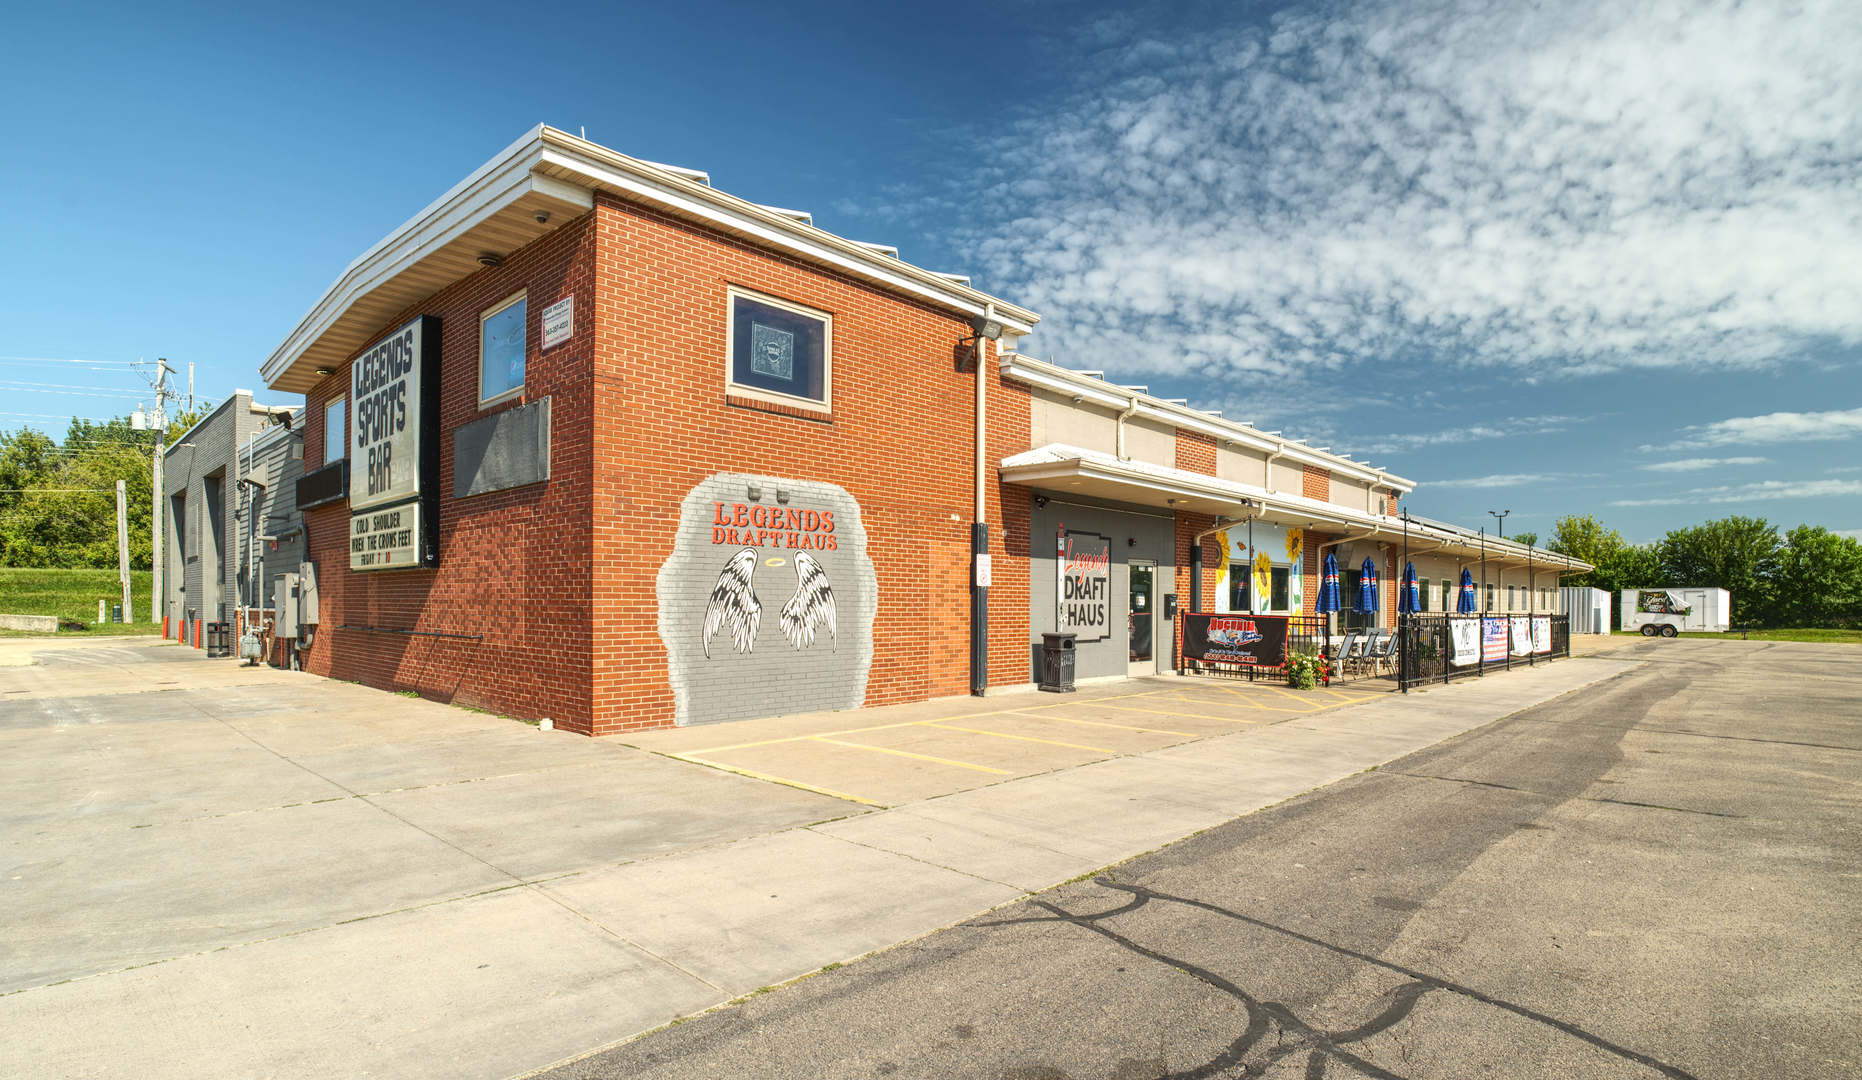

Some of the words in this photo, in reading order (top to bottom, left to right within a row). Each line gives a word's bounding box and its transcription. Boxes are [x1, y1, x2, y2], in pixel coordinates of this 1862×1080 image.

[355, 329, 413, 401] LEGENDS
[358, 379, 406, 448] SPORTS
[368, 440, 392, 496] BAR
[356, 517, 369, 535] COLD
[373, 511, 400, 532] SHOULDER
[712, 500, 834, 533] LEGENDS
[367, 534, 377, 551] THE
[378, 531, 397, 550] CROWS
[398, 529, 411, 547] FEET
[1064, 575, 1107, 601] DRAFT
[1067, 603, 1105, 626] HAUS
